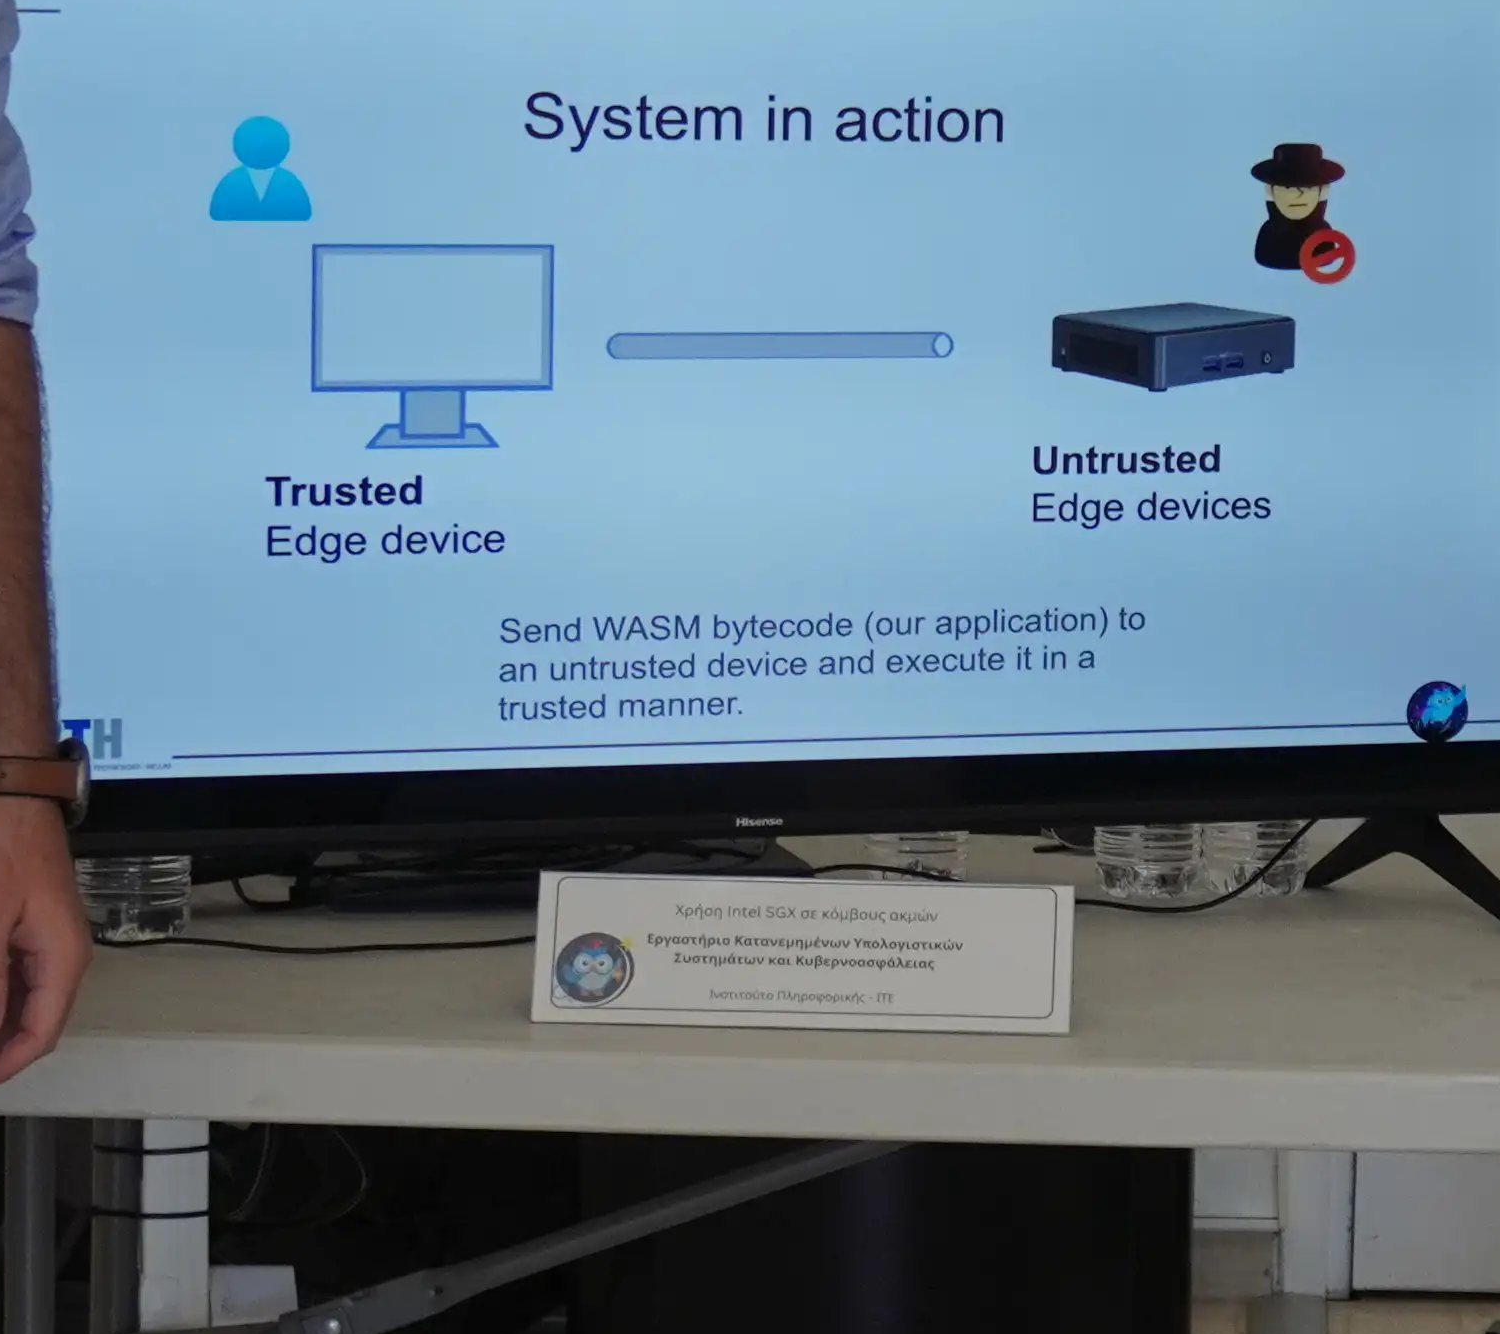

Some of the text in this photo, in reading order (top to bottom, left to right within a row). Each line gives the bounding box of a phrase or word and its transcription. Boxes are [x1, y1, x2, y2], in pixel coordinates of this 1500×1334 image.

[524, 91, 1004, 153] System in action
[1033, 443, 1221, 476] Untrusted
[264, 474, 423, 507] Trusted
[1032, 490, 1272, 530] Edge devices
[267, 523, 506, 564] Edge device
[499, 606, 1146, 647] Send WASM bytecode (our application) to
[498, 644, 1095, 683] an untrusted device and execute it in a
[497, 693, 743, 722] trusted manner.
[675, 903, 938, 924] Χρήση Intel SGX σε κόμβους ακμών
[647, 933, 963, 952] Εργαστήριο Κατανεμημένων Υπολογιστικών
[673, 952, 935, 971] Συστημάτων και Κυβερνοασφάλειας
[709, 988, 774, 1000] Ινστιτούτο
[777, 990, 865, 1005] Πληροφορικής
